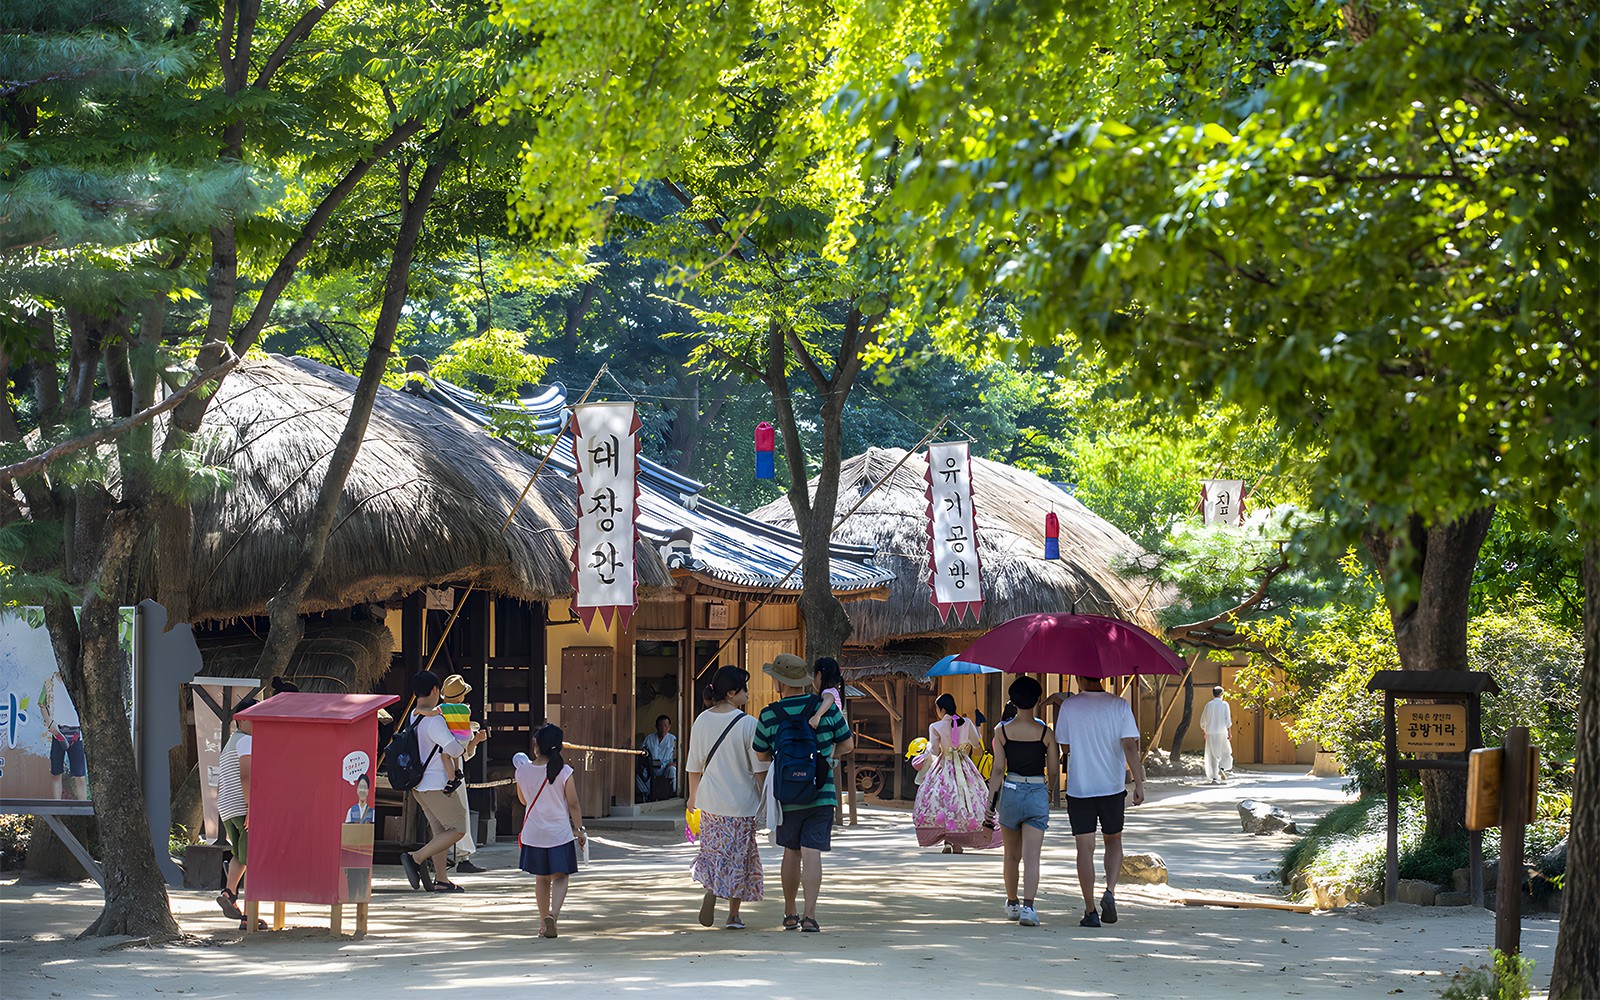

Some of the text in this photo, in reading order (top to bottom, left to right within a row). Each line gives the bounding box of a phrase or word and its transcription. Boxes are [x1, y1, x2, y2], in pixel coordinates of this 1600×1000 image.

[587, 433, 624, 585] 대장간
[938, 457, 970, 590] 유기공방
[1215, 490, 1231, 524] 짚
